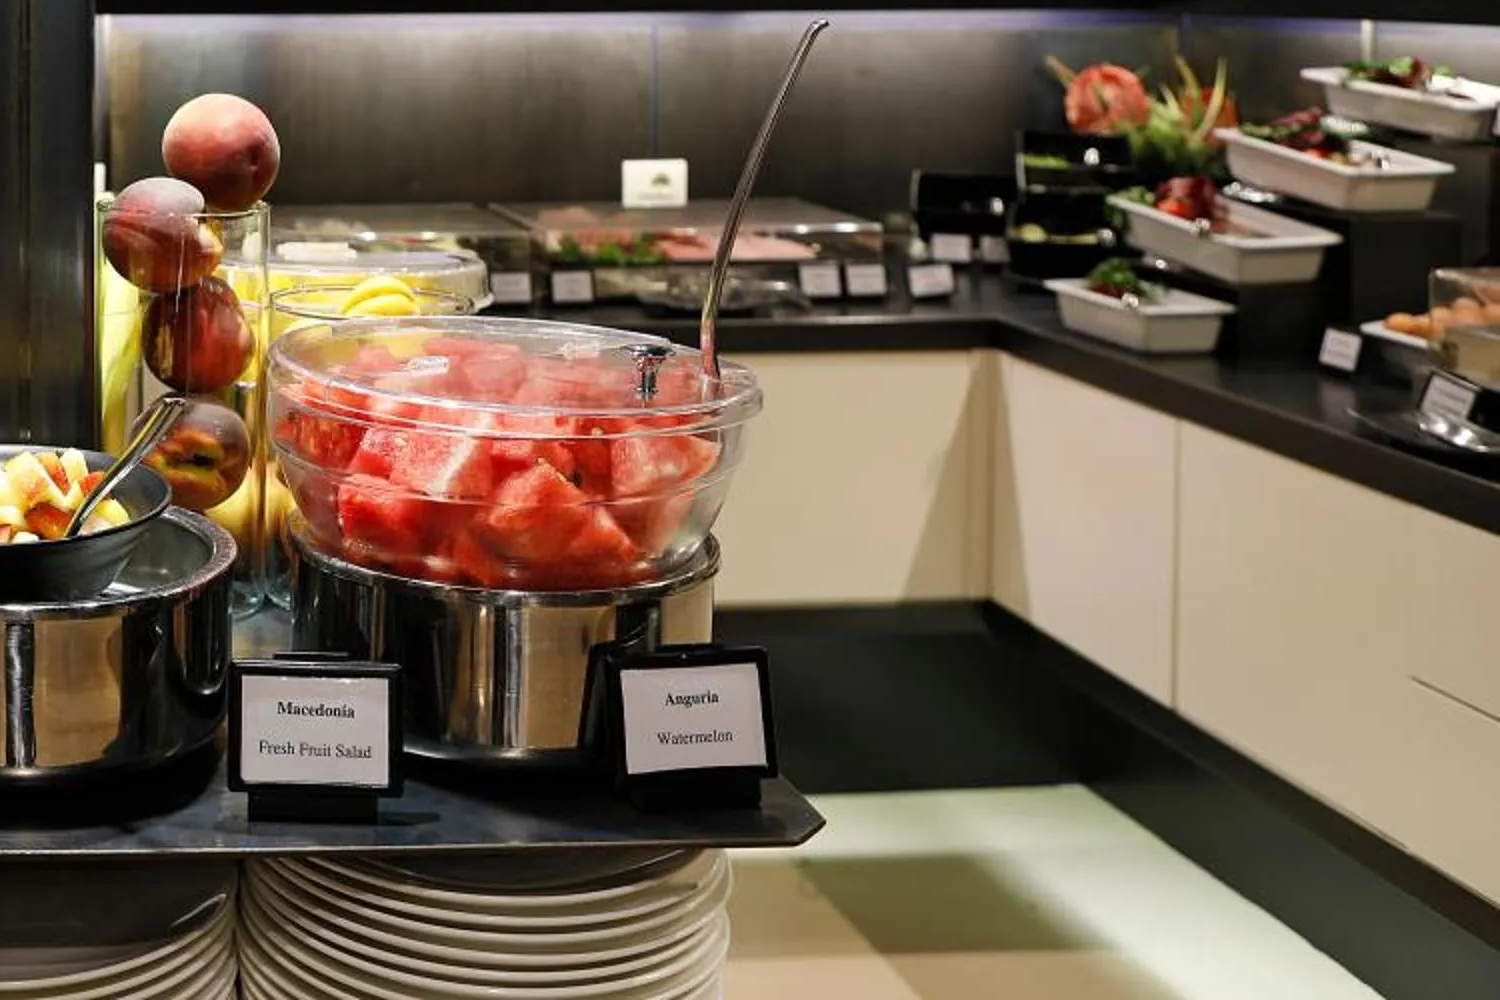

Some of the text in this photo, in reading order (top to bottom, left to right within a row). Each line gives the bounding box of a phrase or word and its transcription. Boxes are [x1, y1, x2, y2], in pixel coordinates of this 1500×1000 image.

[665, 689, 719, 708] Anguria
[276, 701, 355, 718] Macedonia
[657, 728, 734, 745] Watermelon
[258, 739, 373, 759] Fresh Fruit Salad
